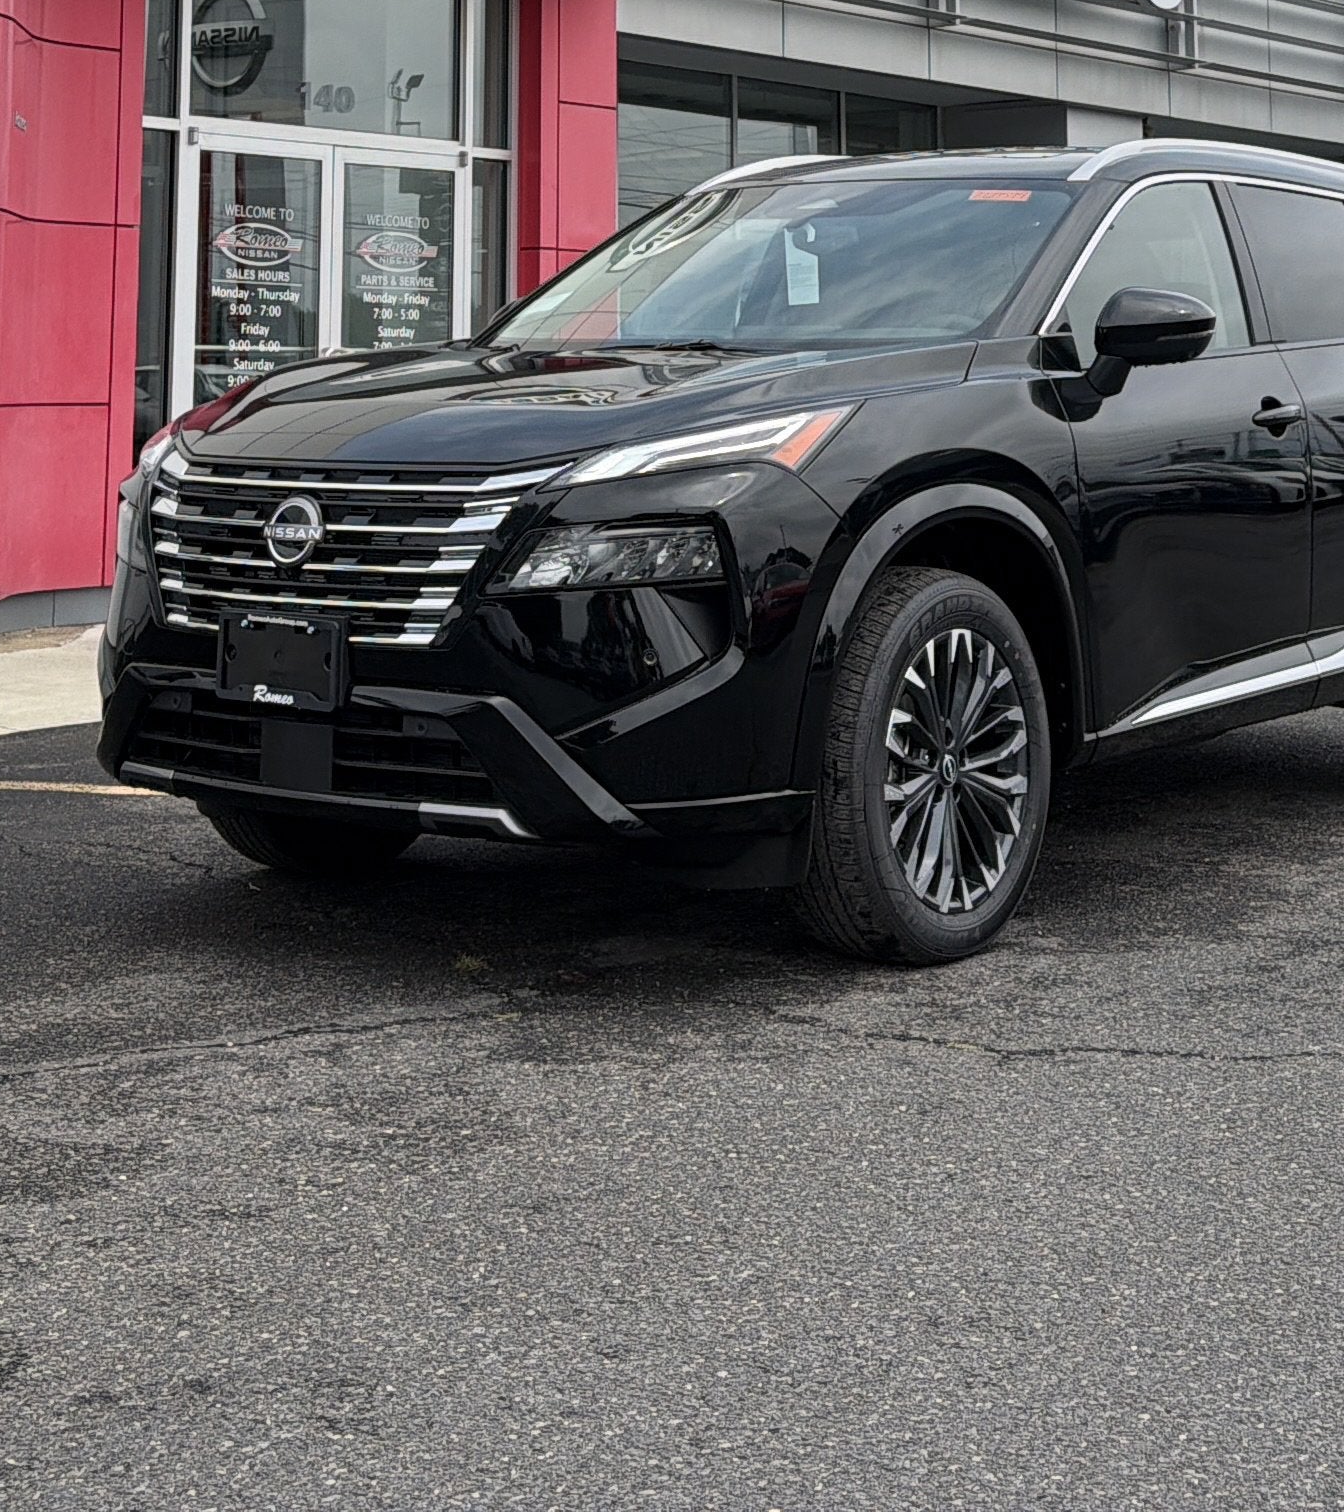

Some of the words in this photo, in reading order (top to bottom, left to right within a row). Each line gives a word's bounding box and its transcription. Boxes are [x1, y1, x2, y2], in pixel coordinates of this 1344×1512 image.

[299, 82, 355, 113] 140
[225, 204, 276, 219] WELCOME
[279, 208, 295, 221] TO
[367, 214, 414, 227] WELCOME
[416, 217, 430, 229] TO
[231, 227, 289, 248] Romeo
[237, 248, 278, 258] NISSAN
[379, 256, 417, 265] NISSAN
[225, 267, 255, 280] SALES
[258, 270, 290, 282] HOURS
[361, 274, 388, 285] PARTS
[390, 275, 397, 285] &
[399, 276, 435, 287] SERVICE
[212, 286, 250, 301] Monday
[257, 288, 301, 303] Thursday
[362, 291, 397, 305] Monday
[404, 293, 431, 306] Friday
[229, 303, 252, 316] 9:00
[260, 305, 282, 317] 7:00
[373, 308, 393, 320] 7:00
[400, 309, 420, 320] 5:00
[240, 323, 270, 337] Friday
[377, 326, 416, 340] Saturday
[229, 339, 250, 352] 9:00
[258, 340, 281, 352] 6:00
[233, 358, 275, 371] Saturday
[263, 526, 321, 539] NISSAN
[253, 684, 295, 706] Romeo
